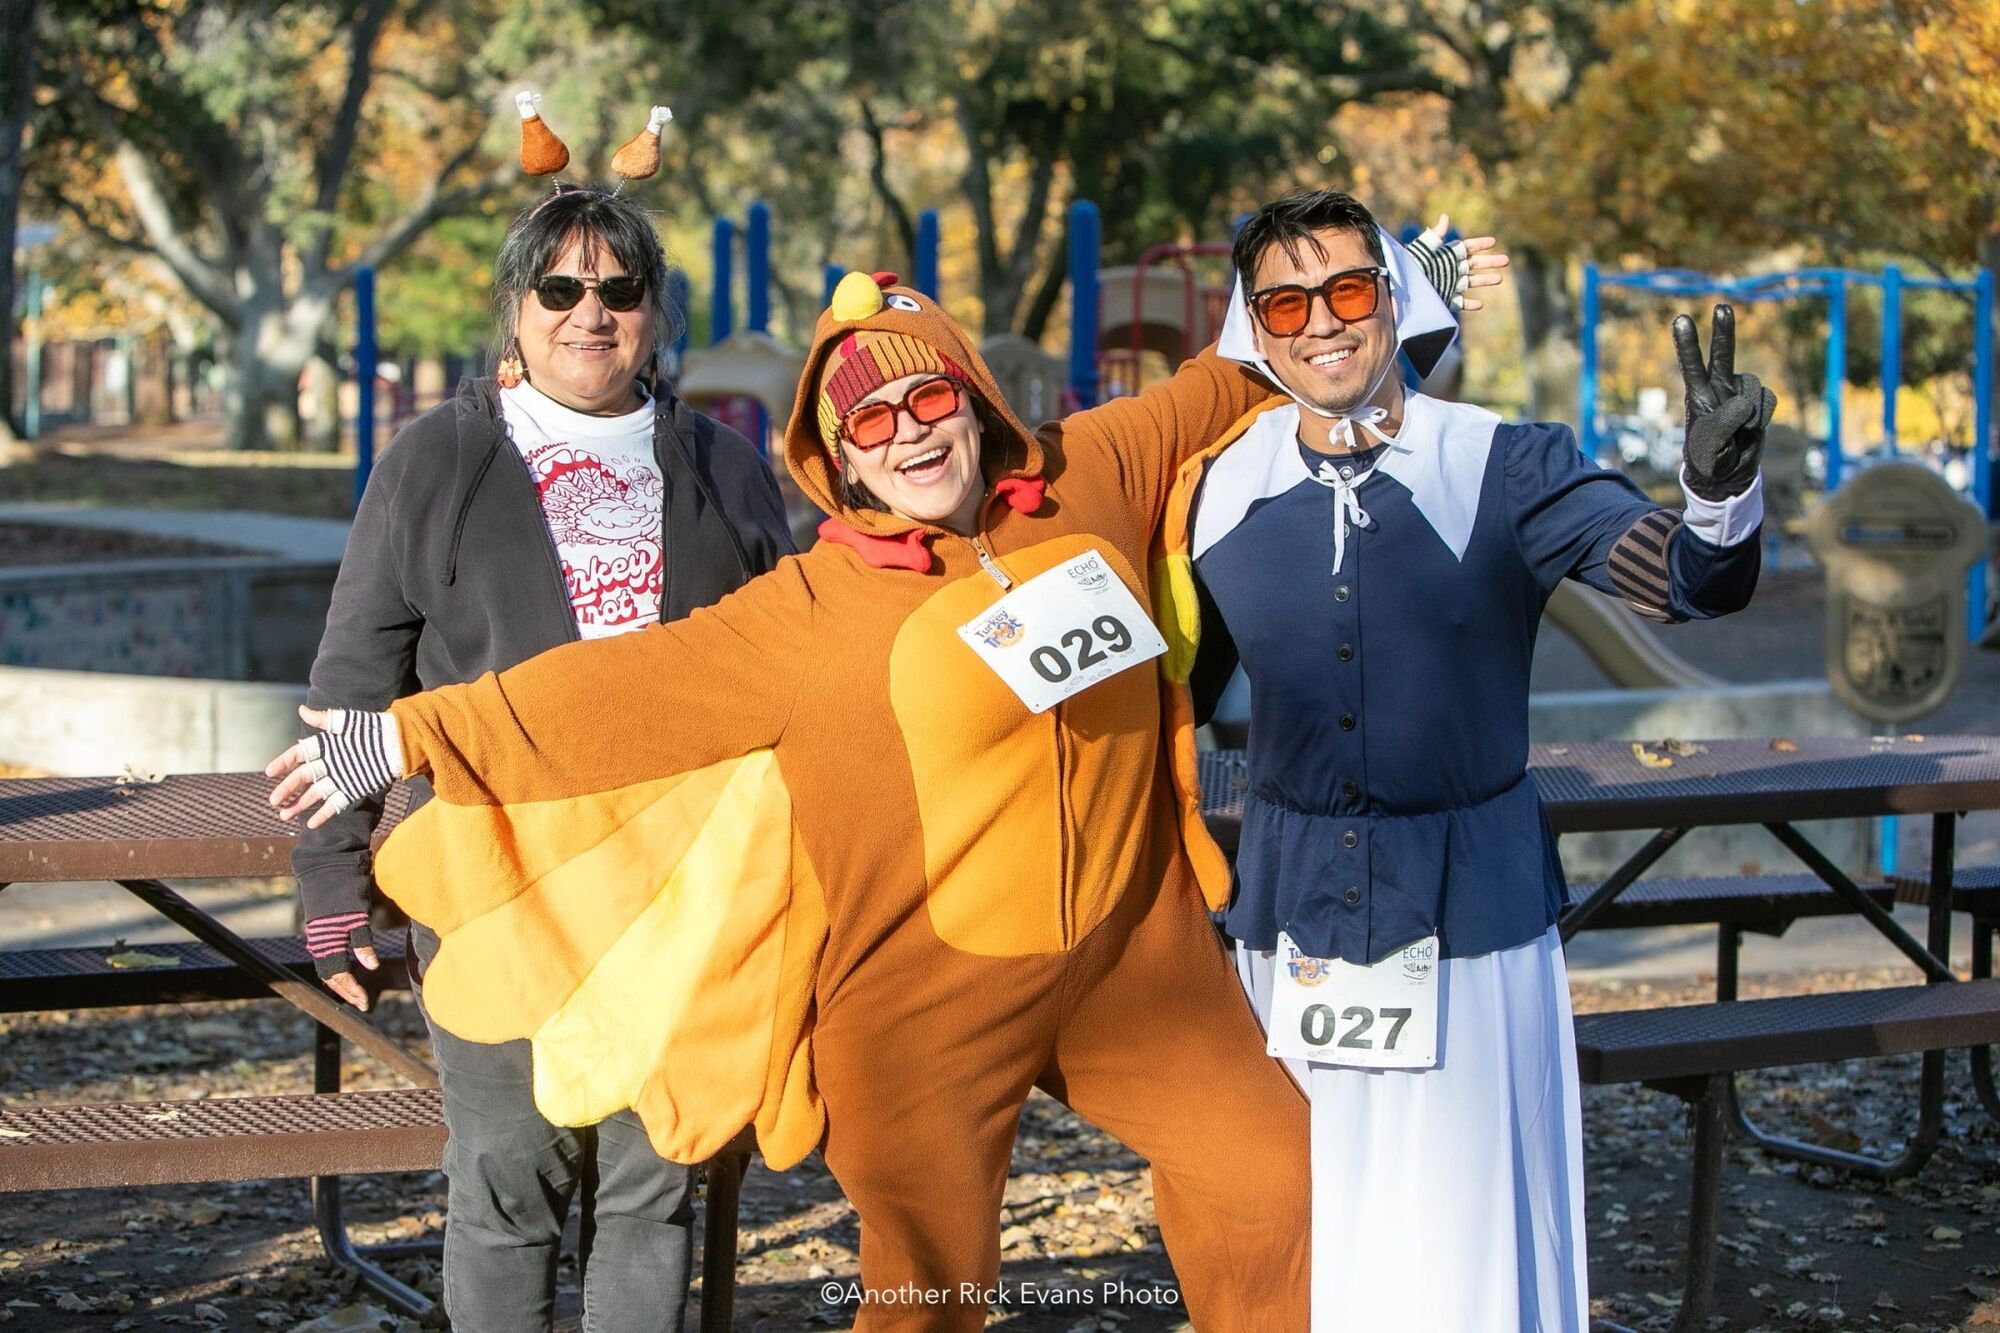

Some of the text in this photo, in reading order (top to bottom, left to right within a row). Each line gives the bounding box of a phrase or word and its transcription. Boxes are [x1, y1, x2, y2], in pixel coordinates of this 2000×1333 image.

[1067, 559, 1099, 579] ECHO
[975, 610, 1009, 638] Turkey
[1030, 615, 1133, 683] 029
[1403, 946, 1433, 959] ECHO
[1301, 1003, 1412, 1050] 027
